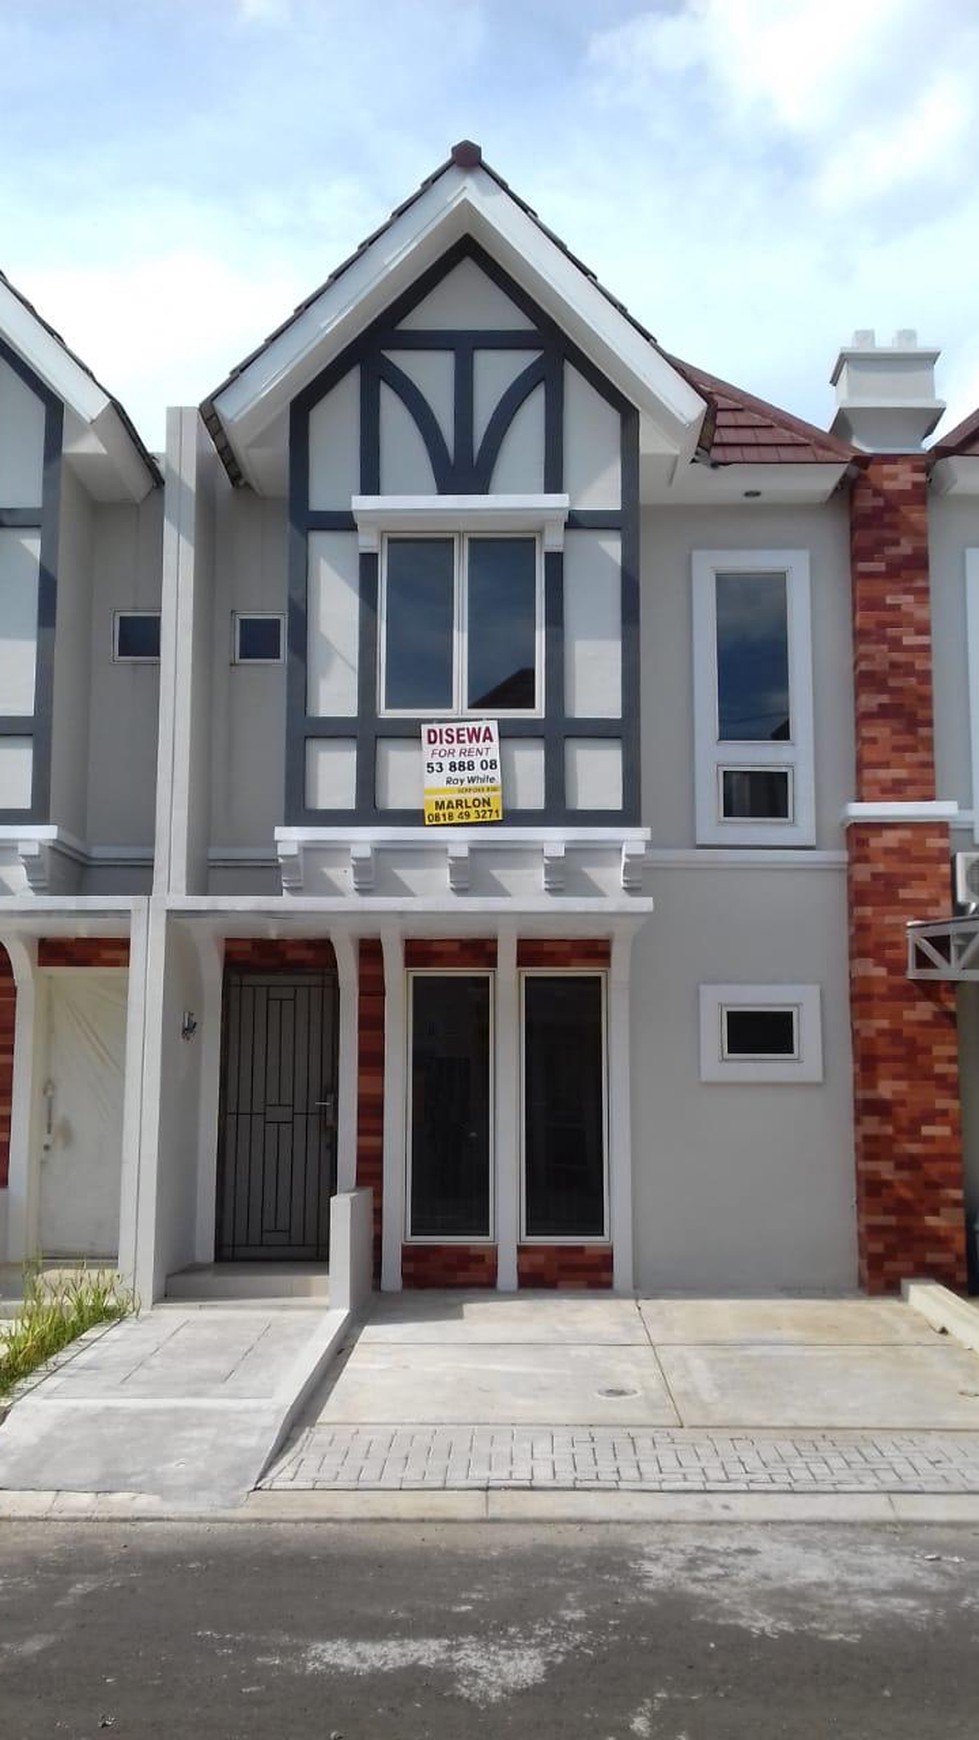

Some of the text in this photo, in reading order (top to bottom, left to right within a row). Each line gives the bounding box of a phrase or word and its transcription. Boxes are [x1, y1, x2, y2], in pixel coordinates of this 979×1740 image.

[427, 726, 494, 745] DISEWA
[431, 747, 491, 758] FOR RENT
[427, 759, 498, 774] 53 888 08
[446, 774, 496, 786] Ray White
[434, 797, 492, 811] MARLON
[427, 812, 454, 823] 0818
[474, 809, 500, 819] 3271
